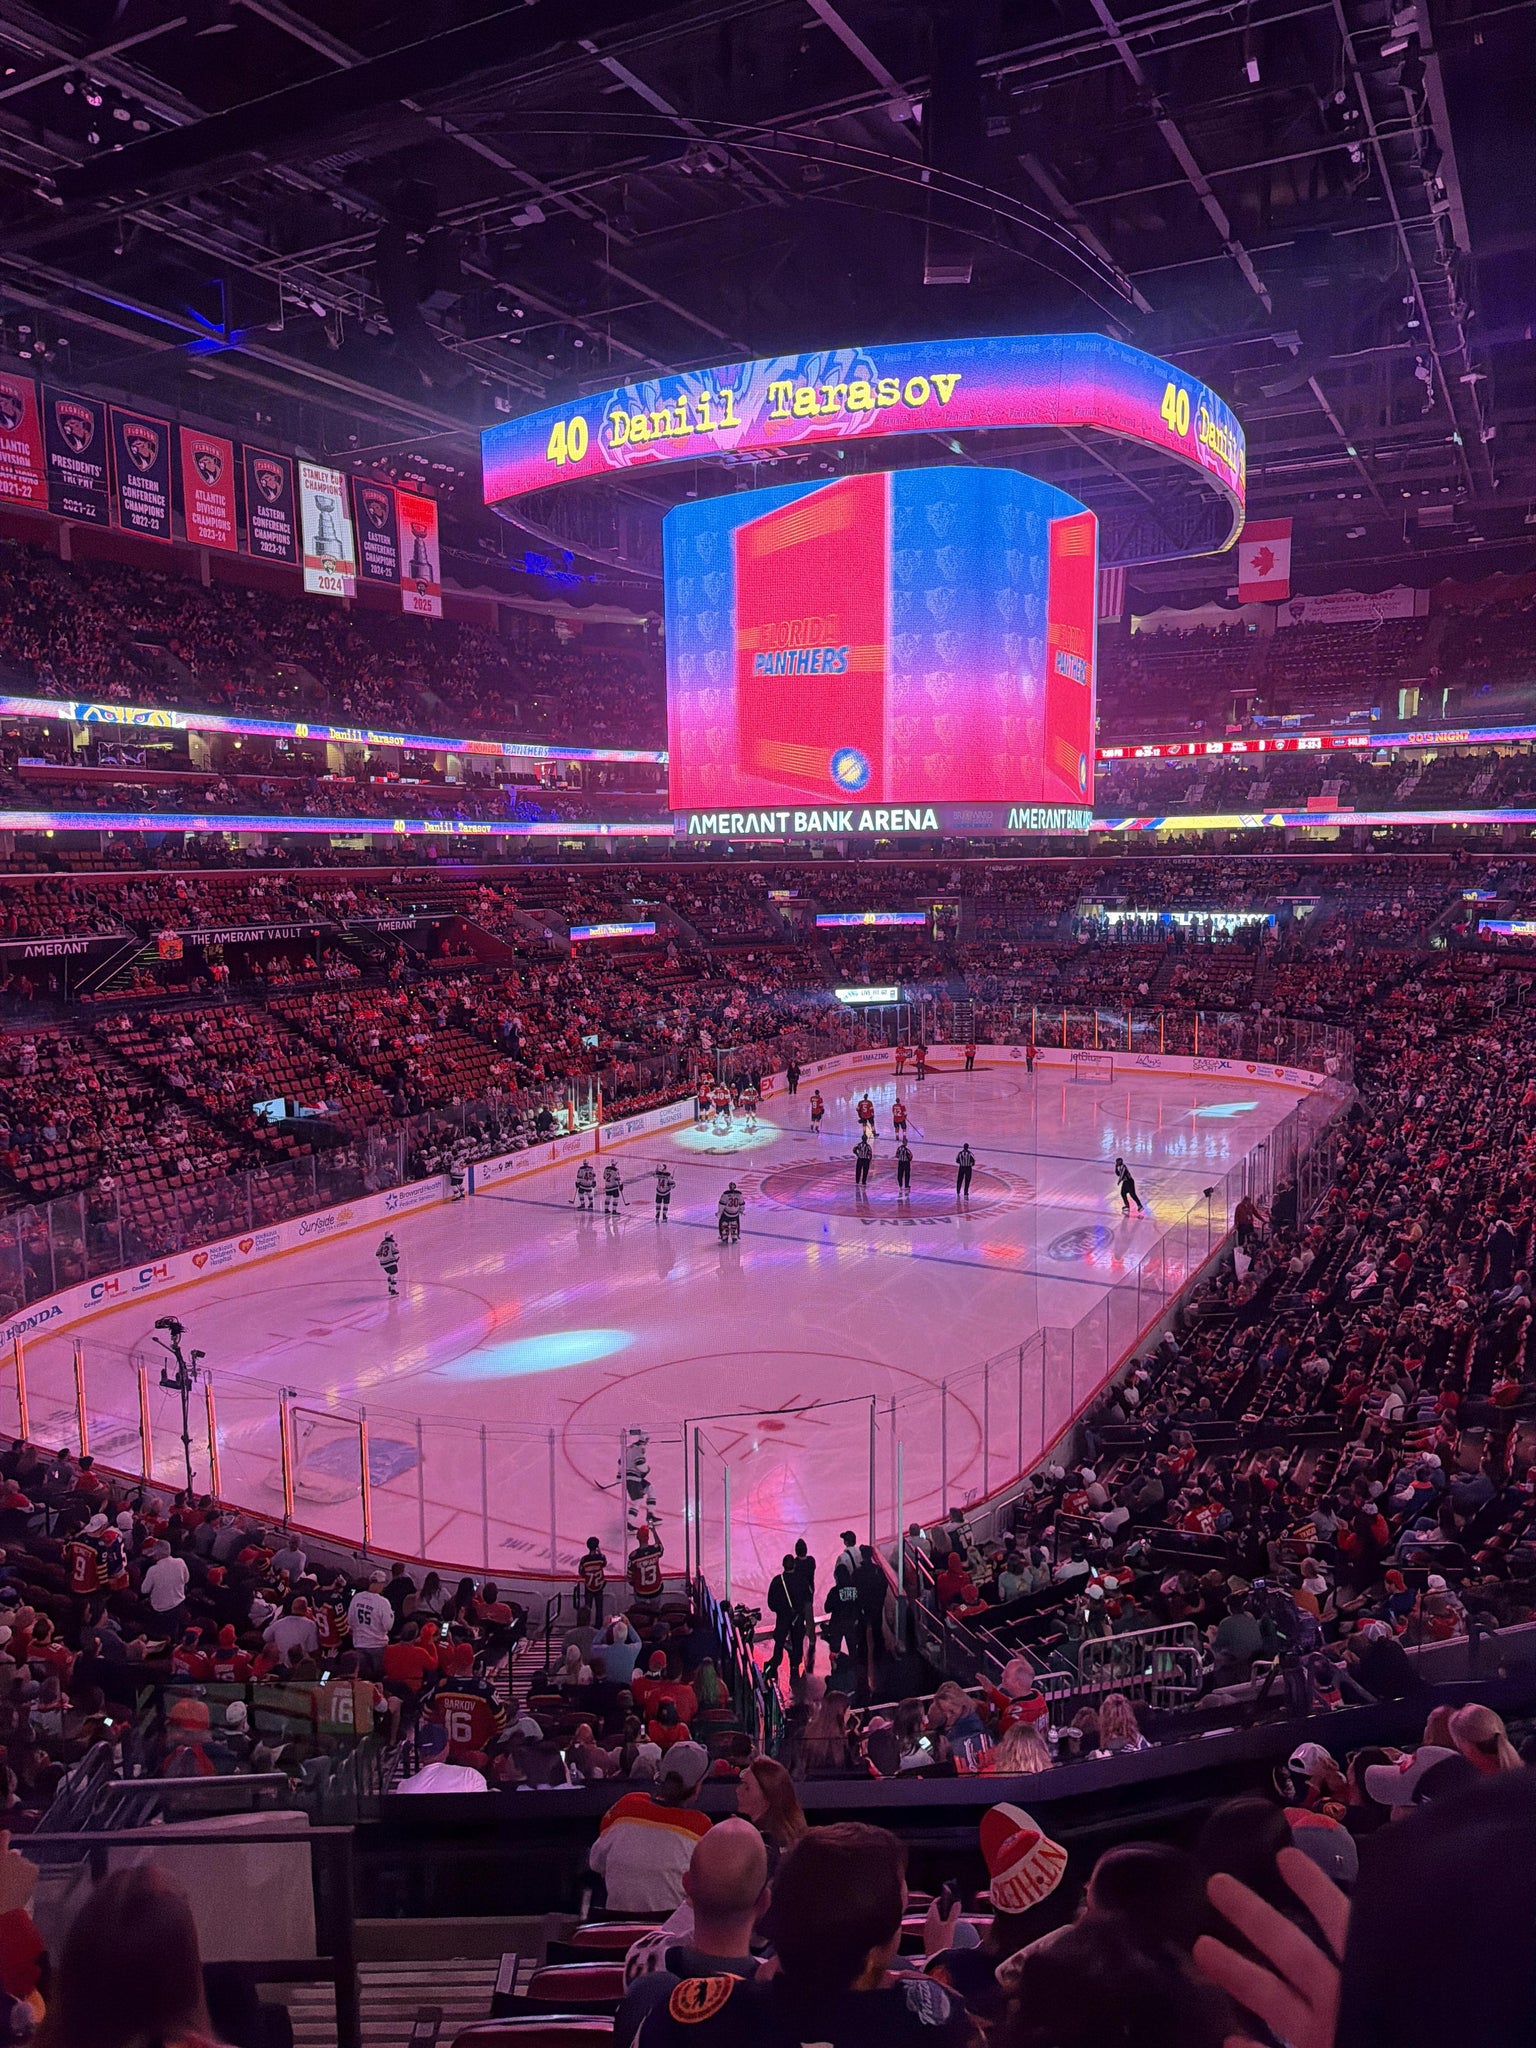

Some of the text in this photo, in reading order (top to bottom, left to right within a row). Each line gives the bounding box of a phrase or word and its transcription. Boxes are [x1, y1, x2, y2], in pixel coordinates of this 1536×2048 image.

[547, 373, 962, 466] 40 Daniil Tarasov
[1160, 382, 1190, 437] 40
[1199, 407, 1237, 473] Daniil
[51, 453, 102, 477] PRESIDENTS'
[127, 474, 159, 492] EASTERN
[302, 467, 330, 484] STANLEY
[121, 485, 166, 507] CONFERENCE
[305, 479, 343, 497] CHAMPIONS
[195, 489, 226, 506] ATLANTIC
[124, 499, 165, 519] CHAMPIONS
[196, 501, 226, 518] DIVISION
[257, 505, 285, 521] EASTERN
[131, 513, 160, 530] 2022-23
[192, 512, 231, 531] CHAMPIONS
[252, 515, 291, 535] CONFERENCE
[198, 526, 226, 542] 2023-24
[254, 527, 291, 546] CHAMPIONS
[367, 531, 392, 545] EASTERN
[260, 541, 286, 557] 2023-24
[363, 540, 396, 558] CONFERENCE
[365, 551, 397, 569] CHAMPIONS
[318, 575, 343, 592] 2024
[413, 597, 433, 613] 2025
[753, 646, 850, 677] PANTHERS
[1054, 651, 1088, 686] PANTHERS
[295, 723, 405, 745] 40 Daniil Tarasov
[1434, 731, 1470, 743] NIGHT
[503, 743, 550, 758] PANTHERS
[392, 819, 492, 834] 40 Daniil Tarasov
[688, 808, 938, 835] AMERANT BANK ARENA
[1008, 808, 1067, 830] AMERANT
[1067, 809, 1083, 830] BANK
[377, 920, 417, 931] AMERANT
[863, 914, 876, 925] 40
[191, 927, 302, 946] THE AMERANT VAULT
[23, 941, 90, 958] AMERANT
[863, 1052, 890, 1062] AMAZING
[1218, 1060, 1233, 1069] XL
[728, 1197, 739, 1208] 30
[298, 1215, 335, 1236] Surfside
[255, 1235, 280, 1247] Children's
[210, 1249, 237, 1261] Children's
[139, 1263, 168, 1283] CH
[90, 1278, 119, 1299] CH
[6, 1304, 63, 1341] HONDA
[73, 1555, 87, 1581] 9
[640, 1565, 657, 1586] 13
[585, 1571, 603, 1587] 72
[444, 1697, 476, 1712] BARKOV
[445, 1709, 472, 1743] 16
